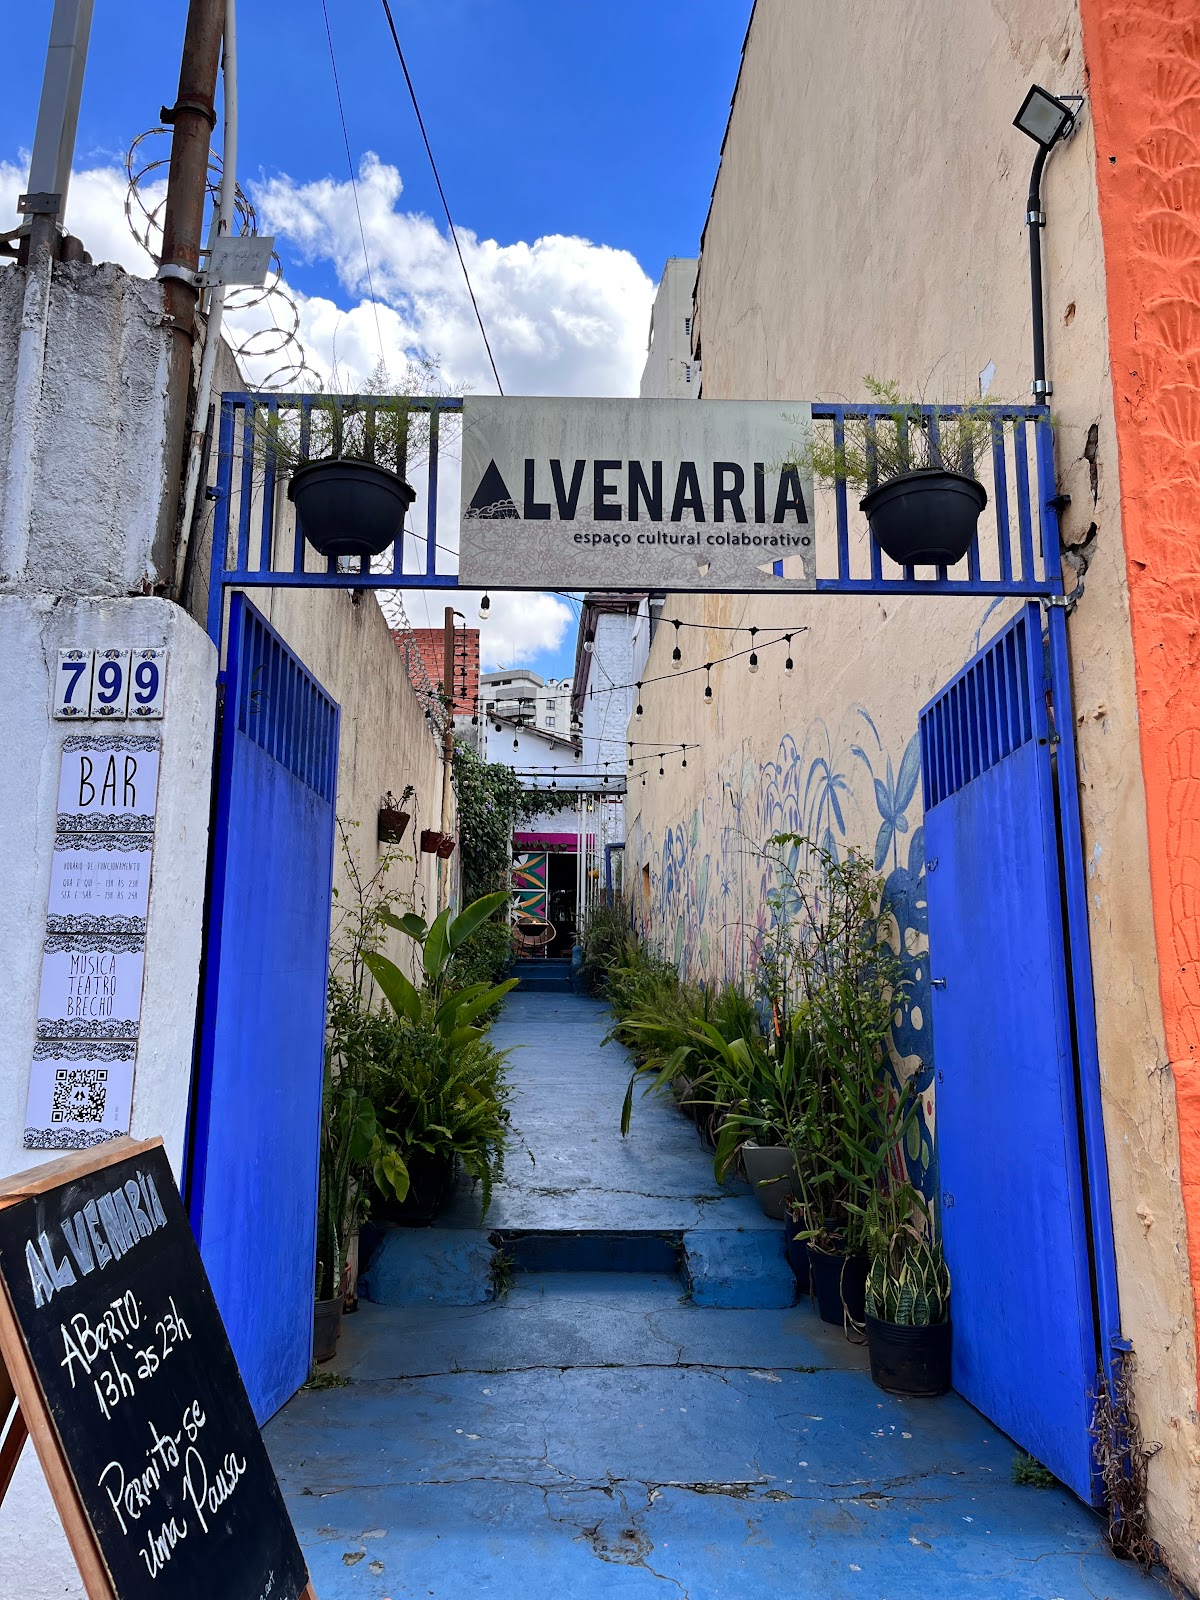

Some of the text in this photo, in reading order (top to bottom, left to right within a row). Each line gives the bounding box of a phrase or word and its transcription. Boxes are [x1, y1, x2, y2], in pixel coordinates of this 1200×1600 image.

[573, 530, 812, 547] espaço cultural colaborativo
[61, 661, 160, 704] 799
[78, 754, 138, 808] BAR
[70, 954, 116, 976] MUSICA
[67, 975, 116, 996] TEATRO
[67, 996, 113, 1017] BRECHO
[94, 1295, 193, 1420] 13h às 23h
[182, 1445, 248, 1534] Pausa
